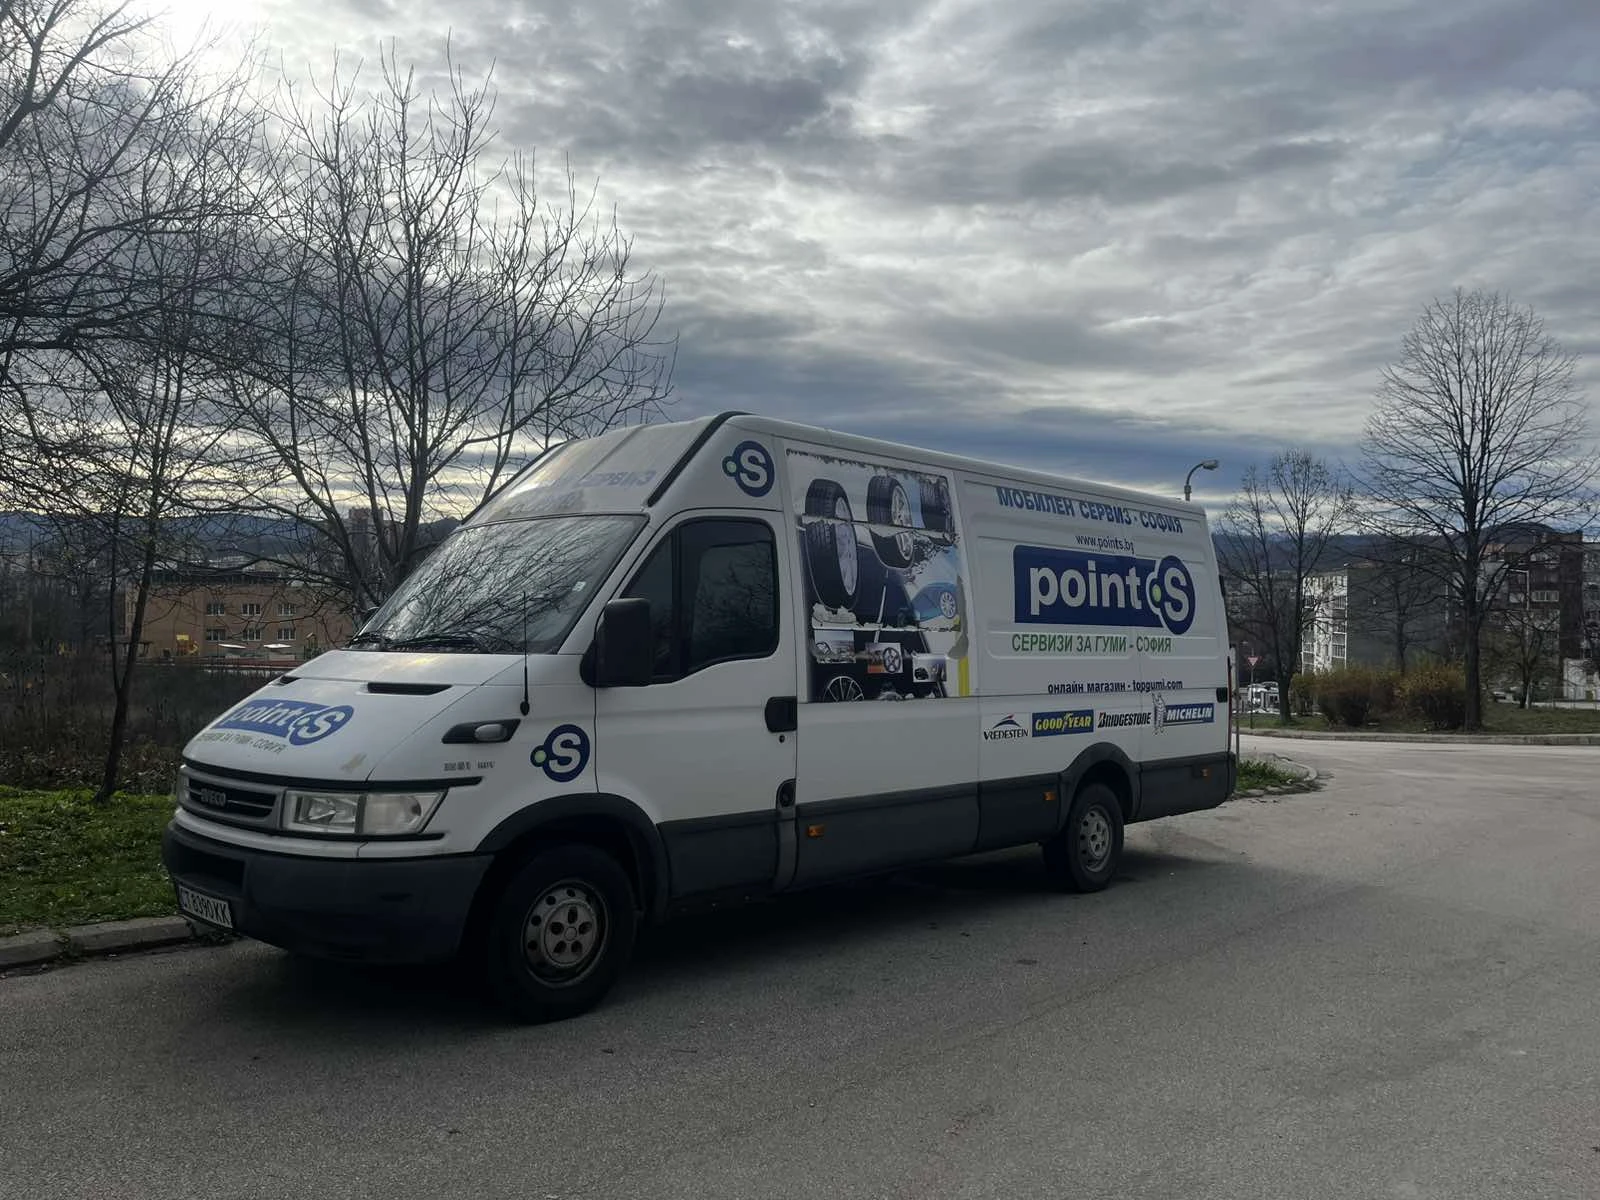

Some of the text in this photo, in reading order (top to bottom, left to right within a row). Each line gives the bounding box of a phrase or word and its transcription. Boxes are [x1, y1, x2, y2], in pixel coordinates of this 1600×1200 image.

[995, 486, 1075, 517] МОБИЛЕН
[1079, 501, 1132, 525] СЕРВИЗ
[1139, 510, 1184, 534] СОФИЯ
[1029, 559, 1143, 616] point
[1011, 633, 1073, 652] СЕРВИЗИ
[1076, 635, 1092, 652] ЗА
[1094, 635, 1127, 653] ГУМИ
[1135, 636, 1172, 653] СОФИЯ
[1047, 681, 1084, 695] онлайн
[1086, 681, 1126, 692] магазин
[1132, 679, 1184, 693] topgumi.com
[1166, 707, 1213, 721] MICHELIN
